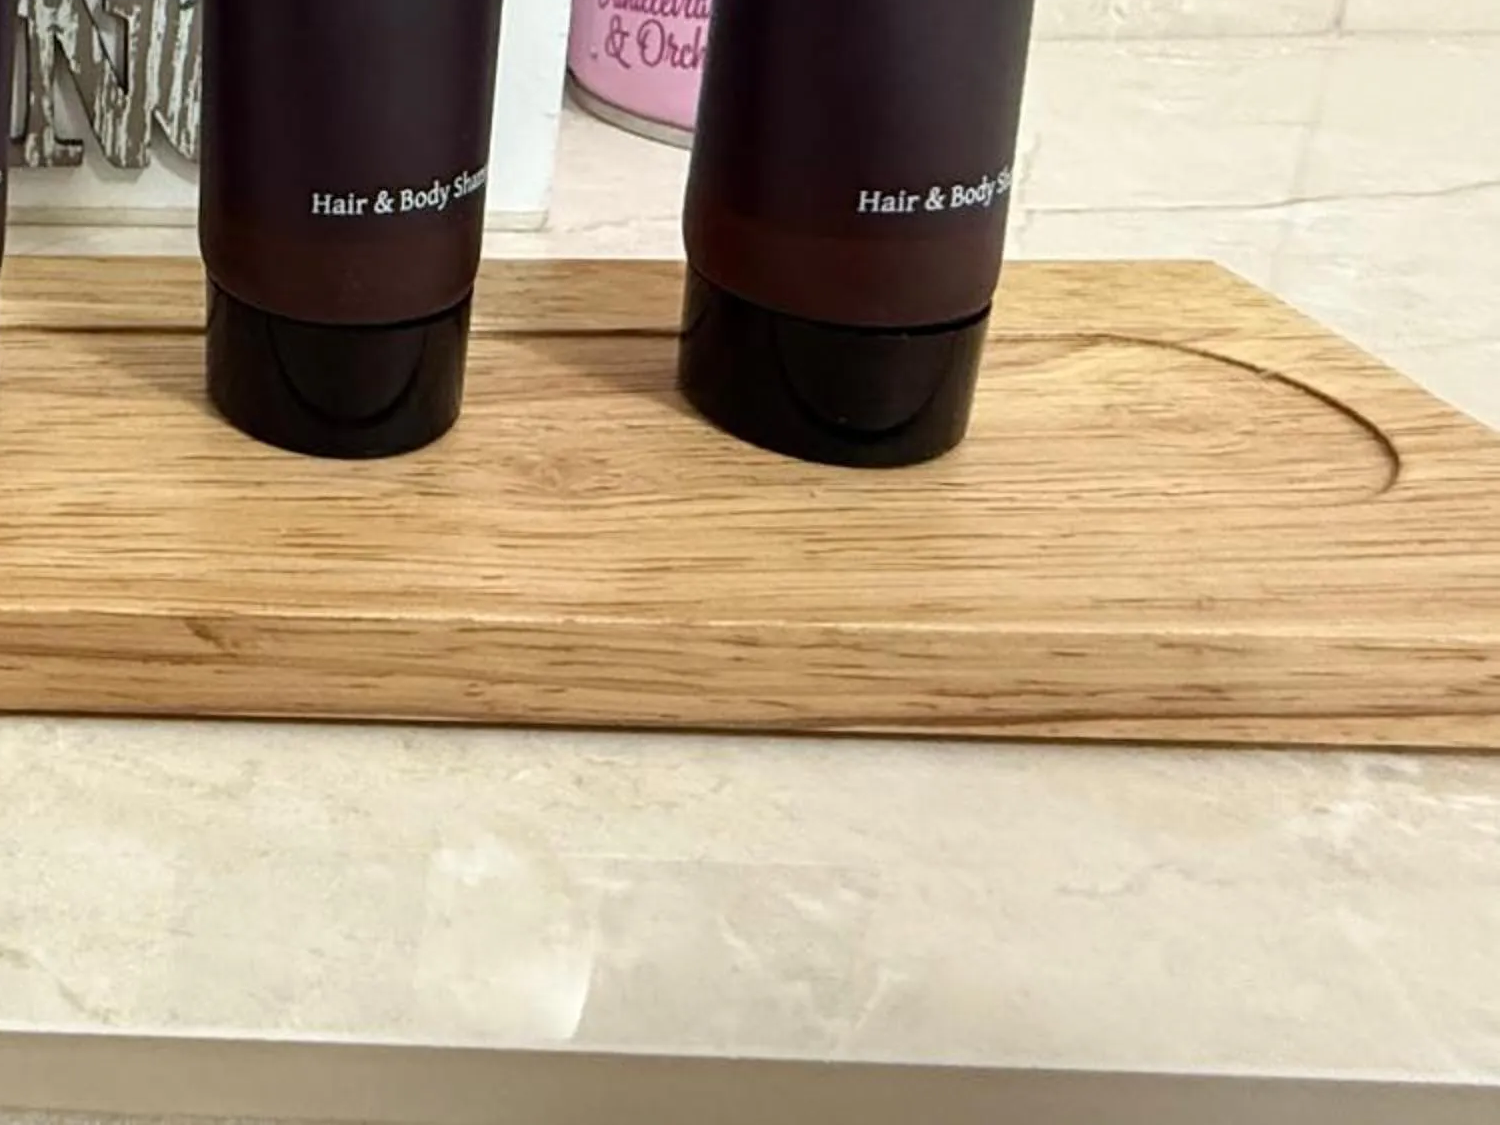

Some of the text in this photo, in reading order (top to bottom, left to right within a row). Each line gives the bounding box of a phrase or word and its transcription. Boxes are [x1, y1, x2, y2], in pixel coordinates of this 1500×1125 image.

[604, 14, 630, 70] &
[311, 192, 369, 215] Hair
[373, 190, 395, 214] &
[400, 179, 450, 211] Body
[857, 189, 920, 213] Hair
[924, 186, 946, 211] &
[950, 174, 996, 207] Body
